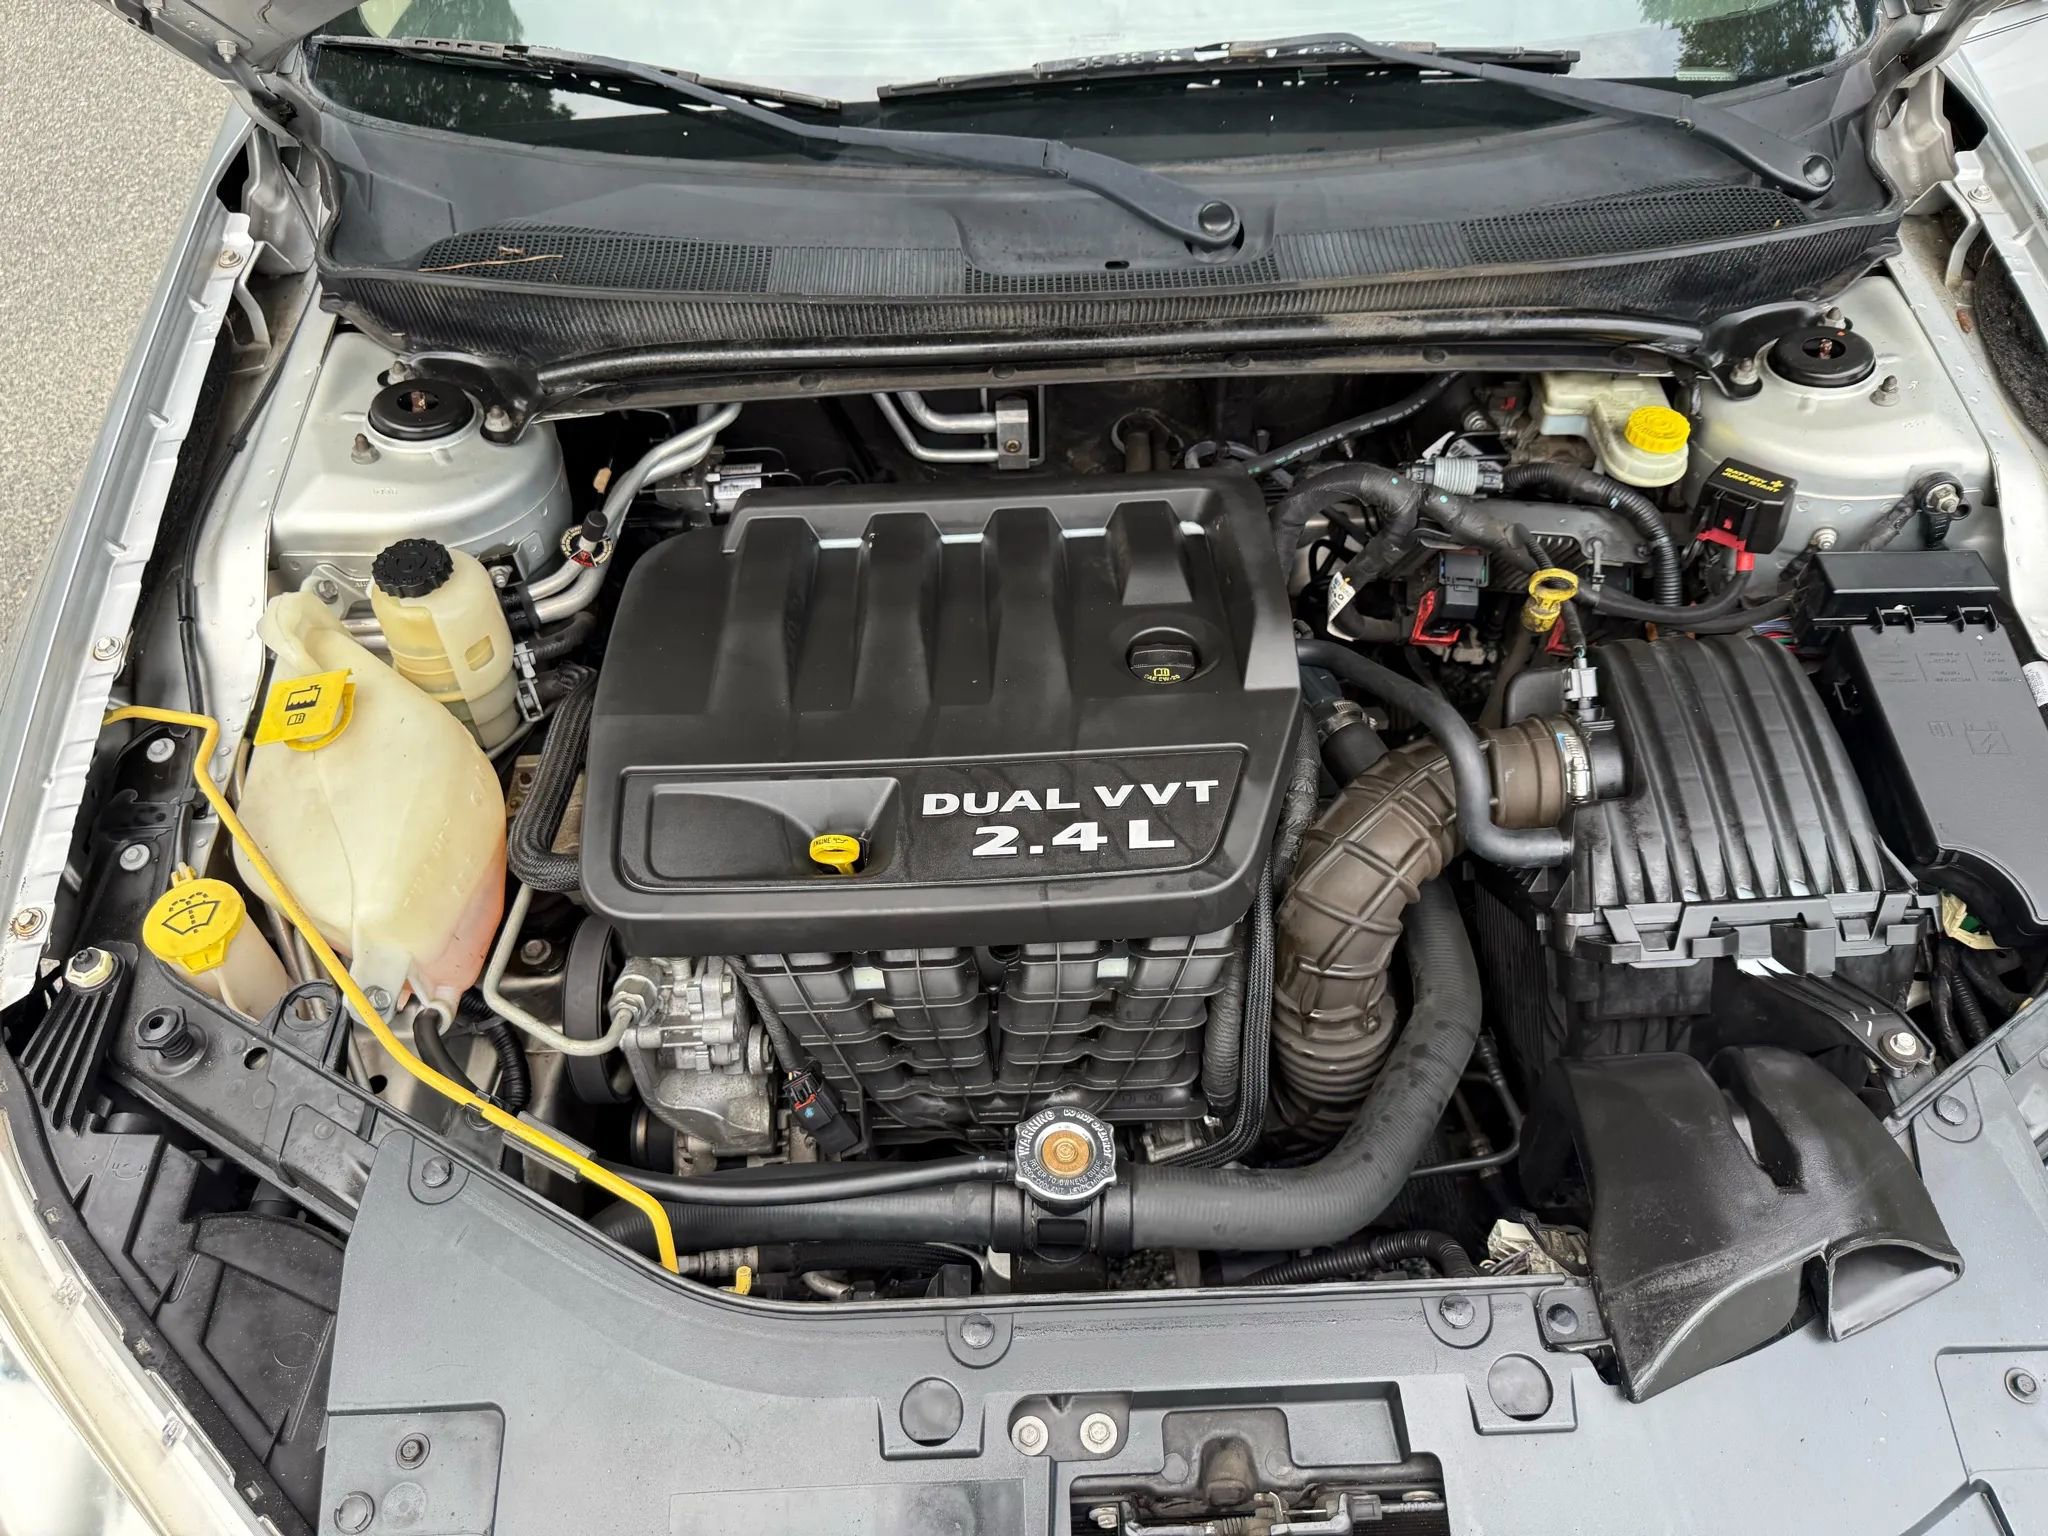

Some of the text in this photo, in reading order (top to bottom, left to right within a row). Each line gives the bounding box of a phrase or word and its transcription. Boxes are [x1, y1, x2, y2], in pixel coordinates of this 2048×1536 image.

[922, 779, 1219, 817] DUAL VVT
[1063, 1108, 1076, 1117] DO
[1076, 1111, 1094, 1124] NOT
[1018, 1110, 1056, 1157] WARNING
[1029, 1158, 1048, 1179] REFER
[1048, 1175, 1057, 1184] TO
[1059, 1175, 1088, 1186] OWNERS
[1036, 1178, 1064, 1194] COOLANT
